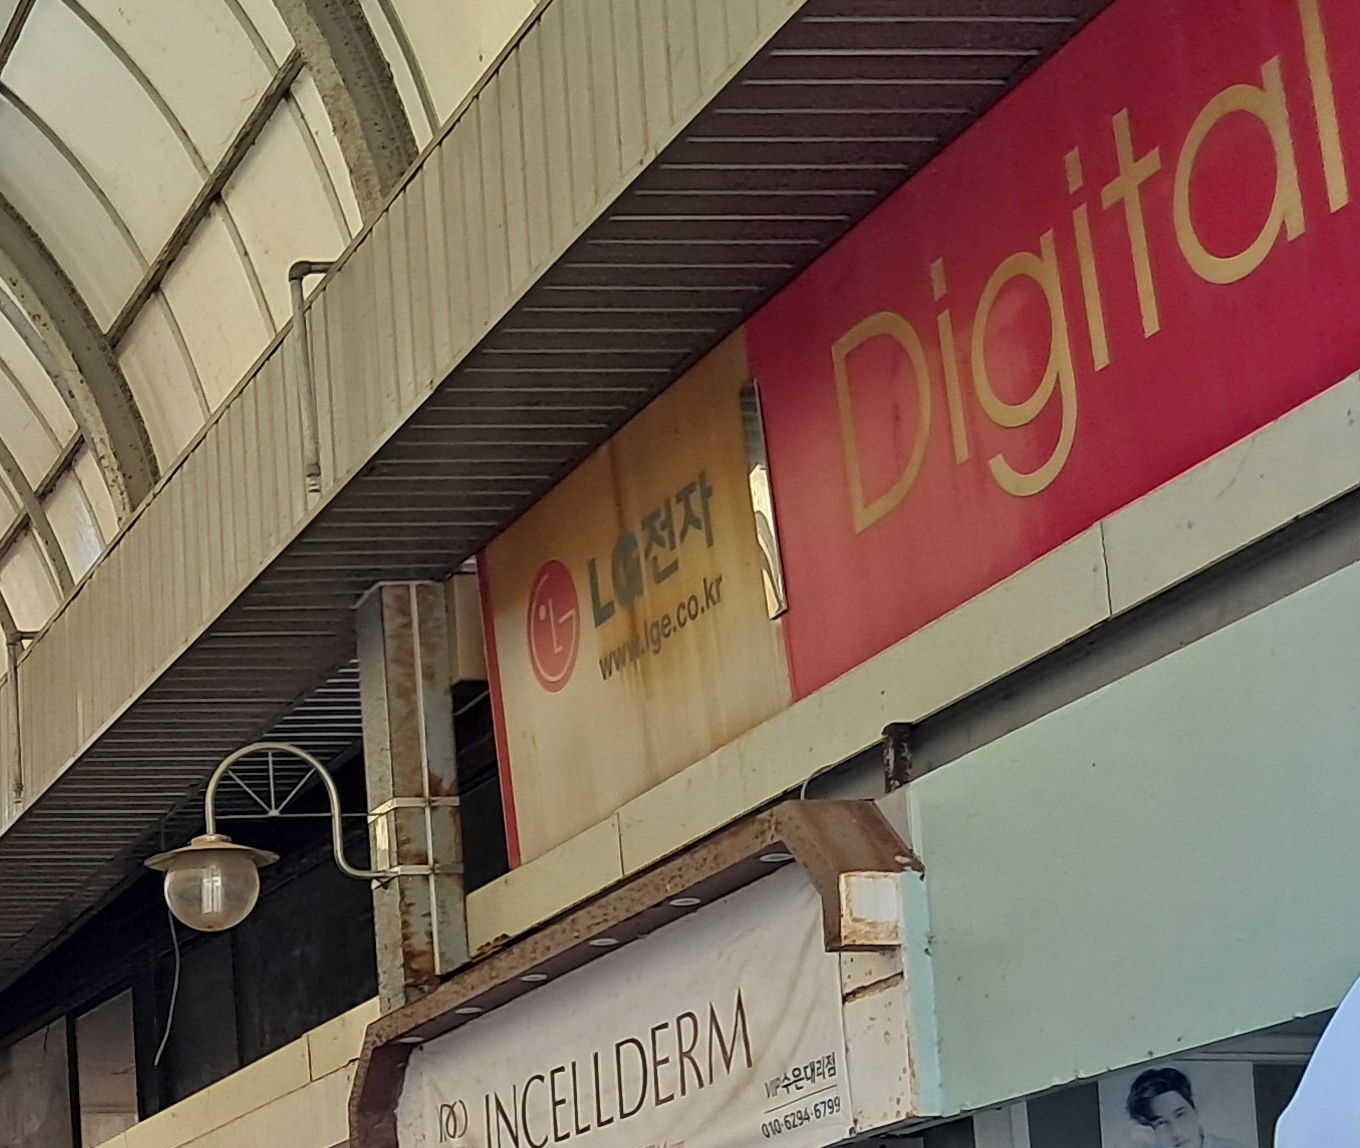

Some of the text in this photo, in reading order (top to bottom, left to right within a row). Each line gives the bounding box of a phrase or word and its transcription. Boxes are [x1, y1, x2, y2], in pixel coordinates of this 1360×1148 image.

[831, 0, 1349, 534] Digital
[587, 470, 714, 628] LG전자
[598, 575, 723, 681] www.lge.co.kr
